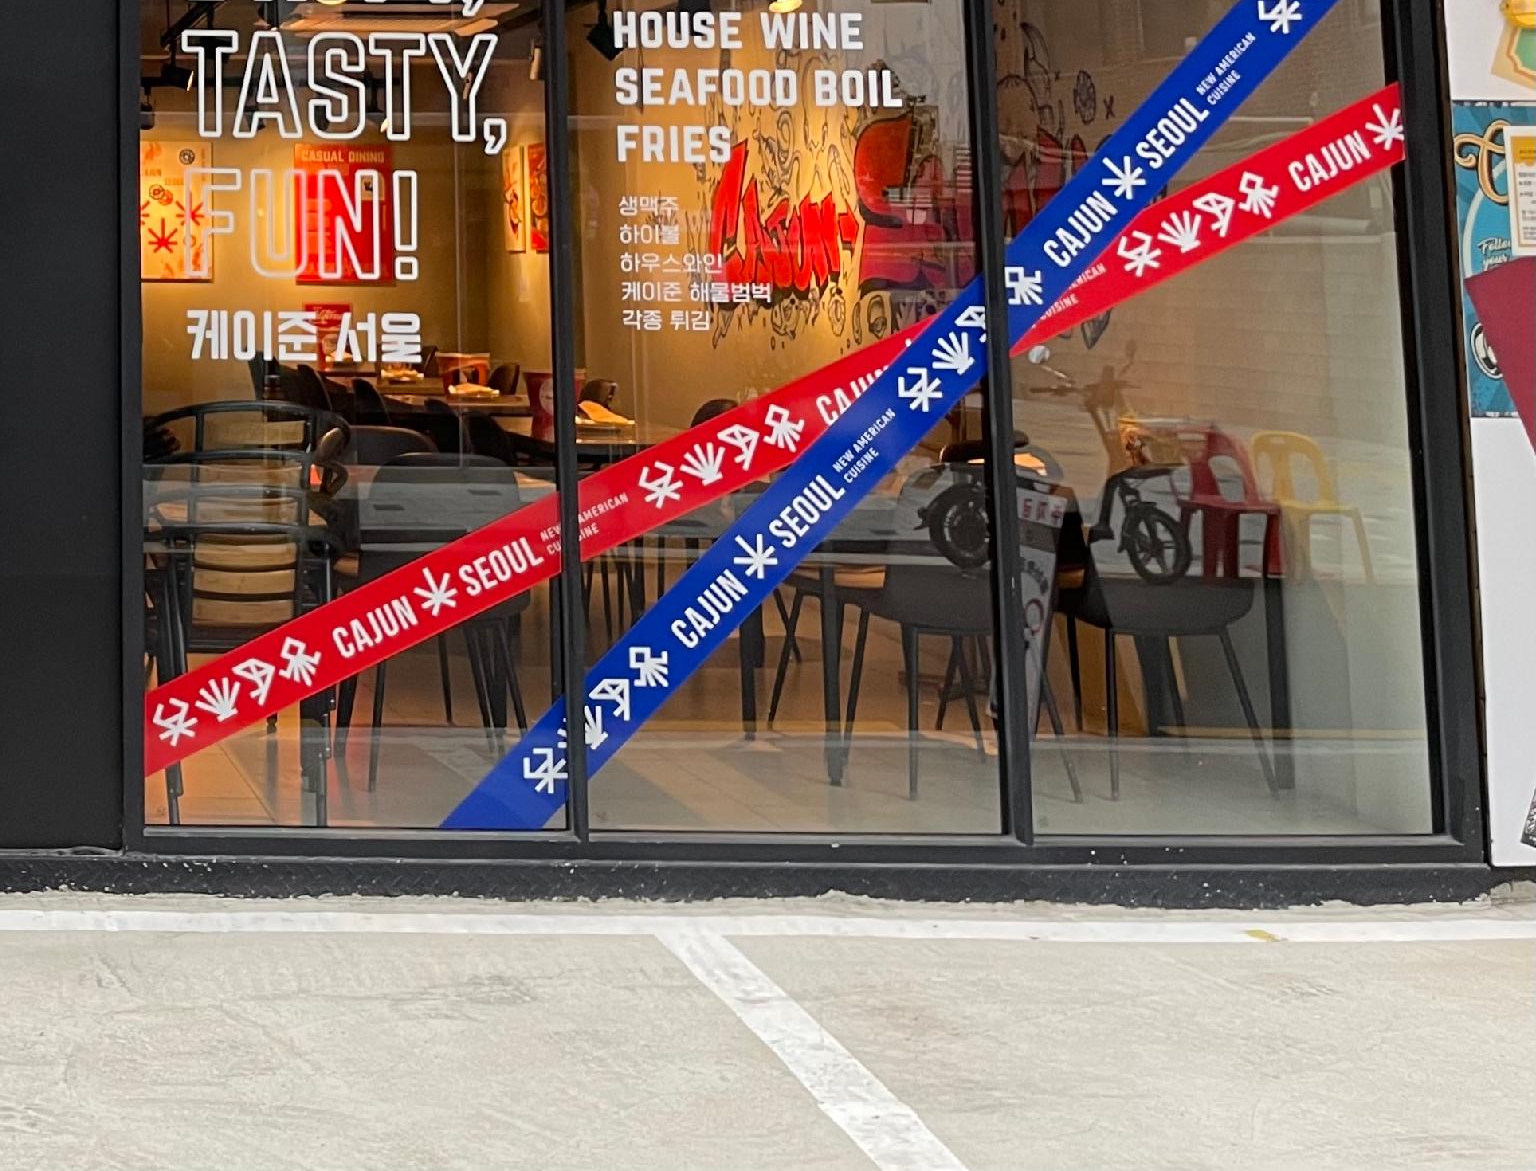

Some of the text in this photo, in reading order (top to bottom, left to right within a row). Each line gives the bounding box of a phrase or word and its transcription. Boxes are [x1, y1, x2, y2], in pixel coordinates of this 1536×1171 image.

[612, 11, 864, 49] HOUSE WINE
[1196, 32, 1256, 96] NEW AMERICAN
[181, 30, 507, 154] TASTY,
[615, 67, 904, 108] SEAFOOD BOIL
[1207, 70, 1241, 105] CUISINE
[300, 149, 385, 163] CASUAL DINING
[616, 124, 733, 163] FRIES
[1286, 130, 1372, 193] CAJUN
[1042, 97, 1210, 268] CAJUN SEOUL
[183, 168, 420, 281] FUN!
[618, 196, 680, 217] 생맥주
[620, 251, 723, 274] 하우스와인
[621, 282, 772, 303] 케이준 해물범벅
[186, 310, 423, 364] 케이준 서울
[622, 309, 711, 331] 각종 튀김
[832, 407, 897, 473] NEW AMERICAN
[843, 447, 880, 484] CUISINE
[578, 492, 629, 524] AMERICAN
[671, 473, 846, 649] CAJUN SEOUL
[331, 536, 544, 659] CAJUN SEOUL
